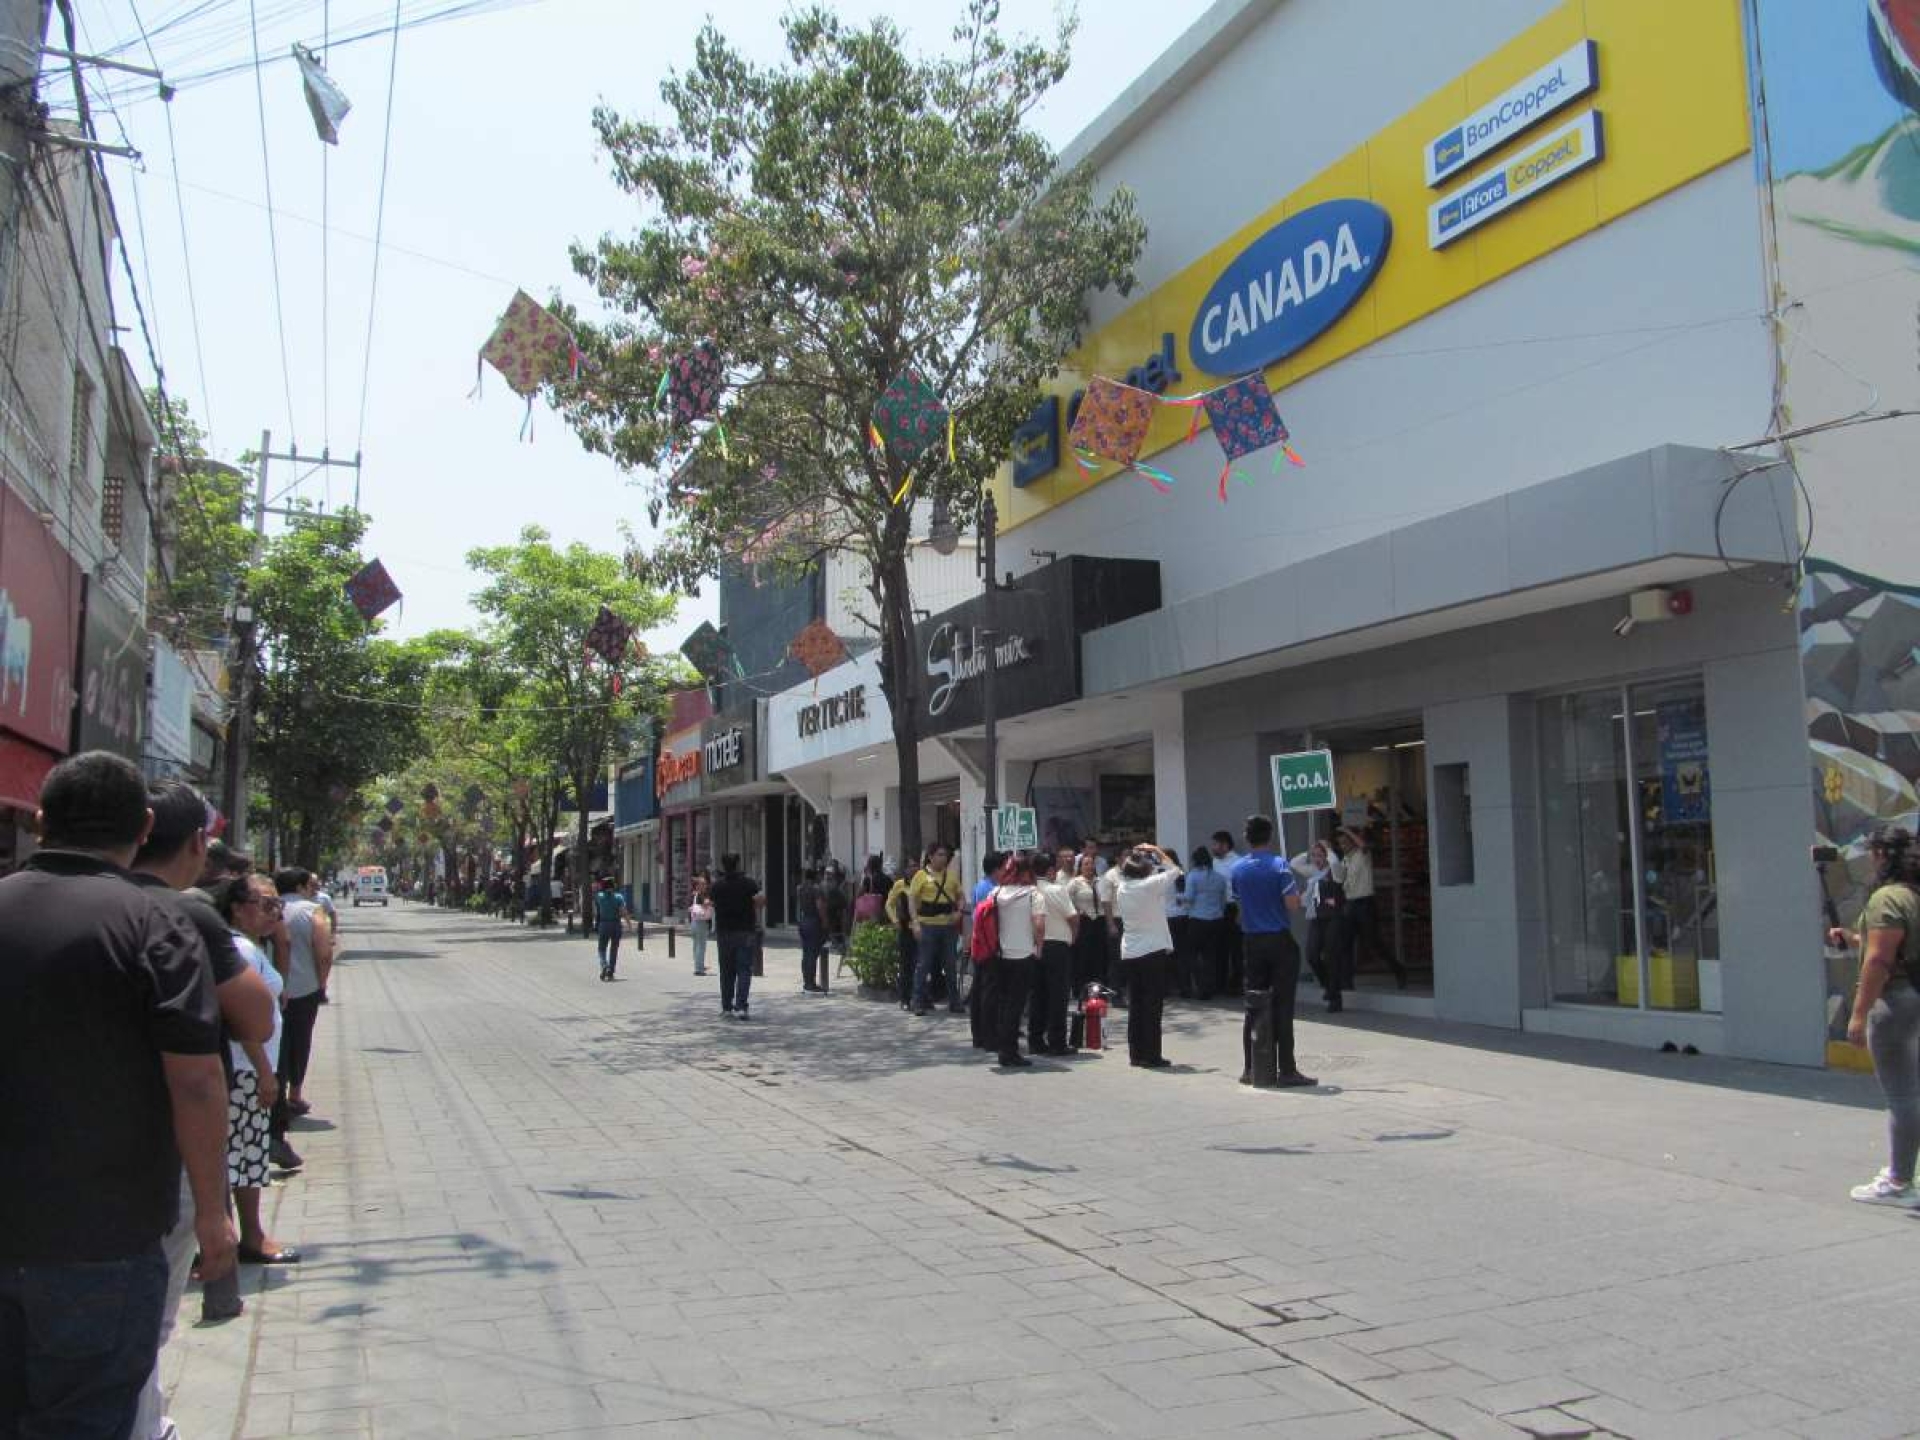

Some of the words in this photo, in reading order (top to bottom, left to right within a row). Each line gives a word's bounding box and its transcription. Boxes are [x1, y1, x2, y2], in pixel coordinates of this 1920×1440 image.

[1466, 64, 1568, 148] BanCoppel
[1464, 182, 1504, 213] Afore
[1514, 140, 1574, 186] Coppel
[1281, 772, 1329, 791] C.O.A.
